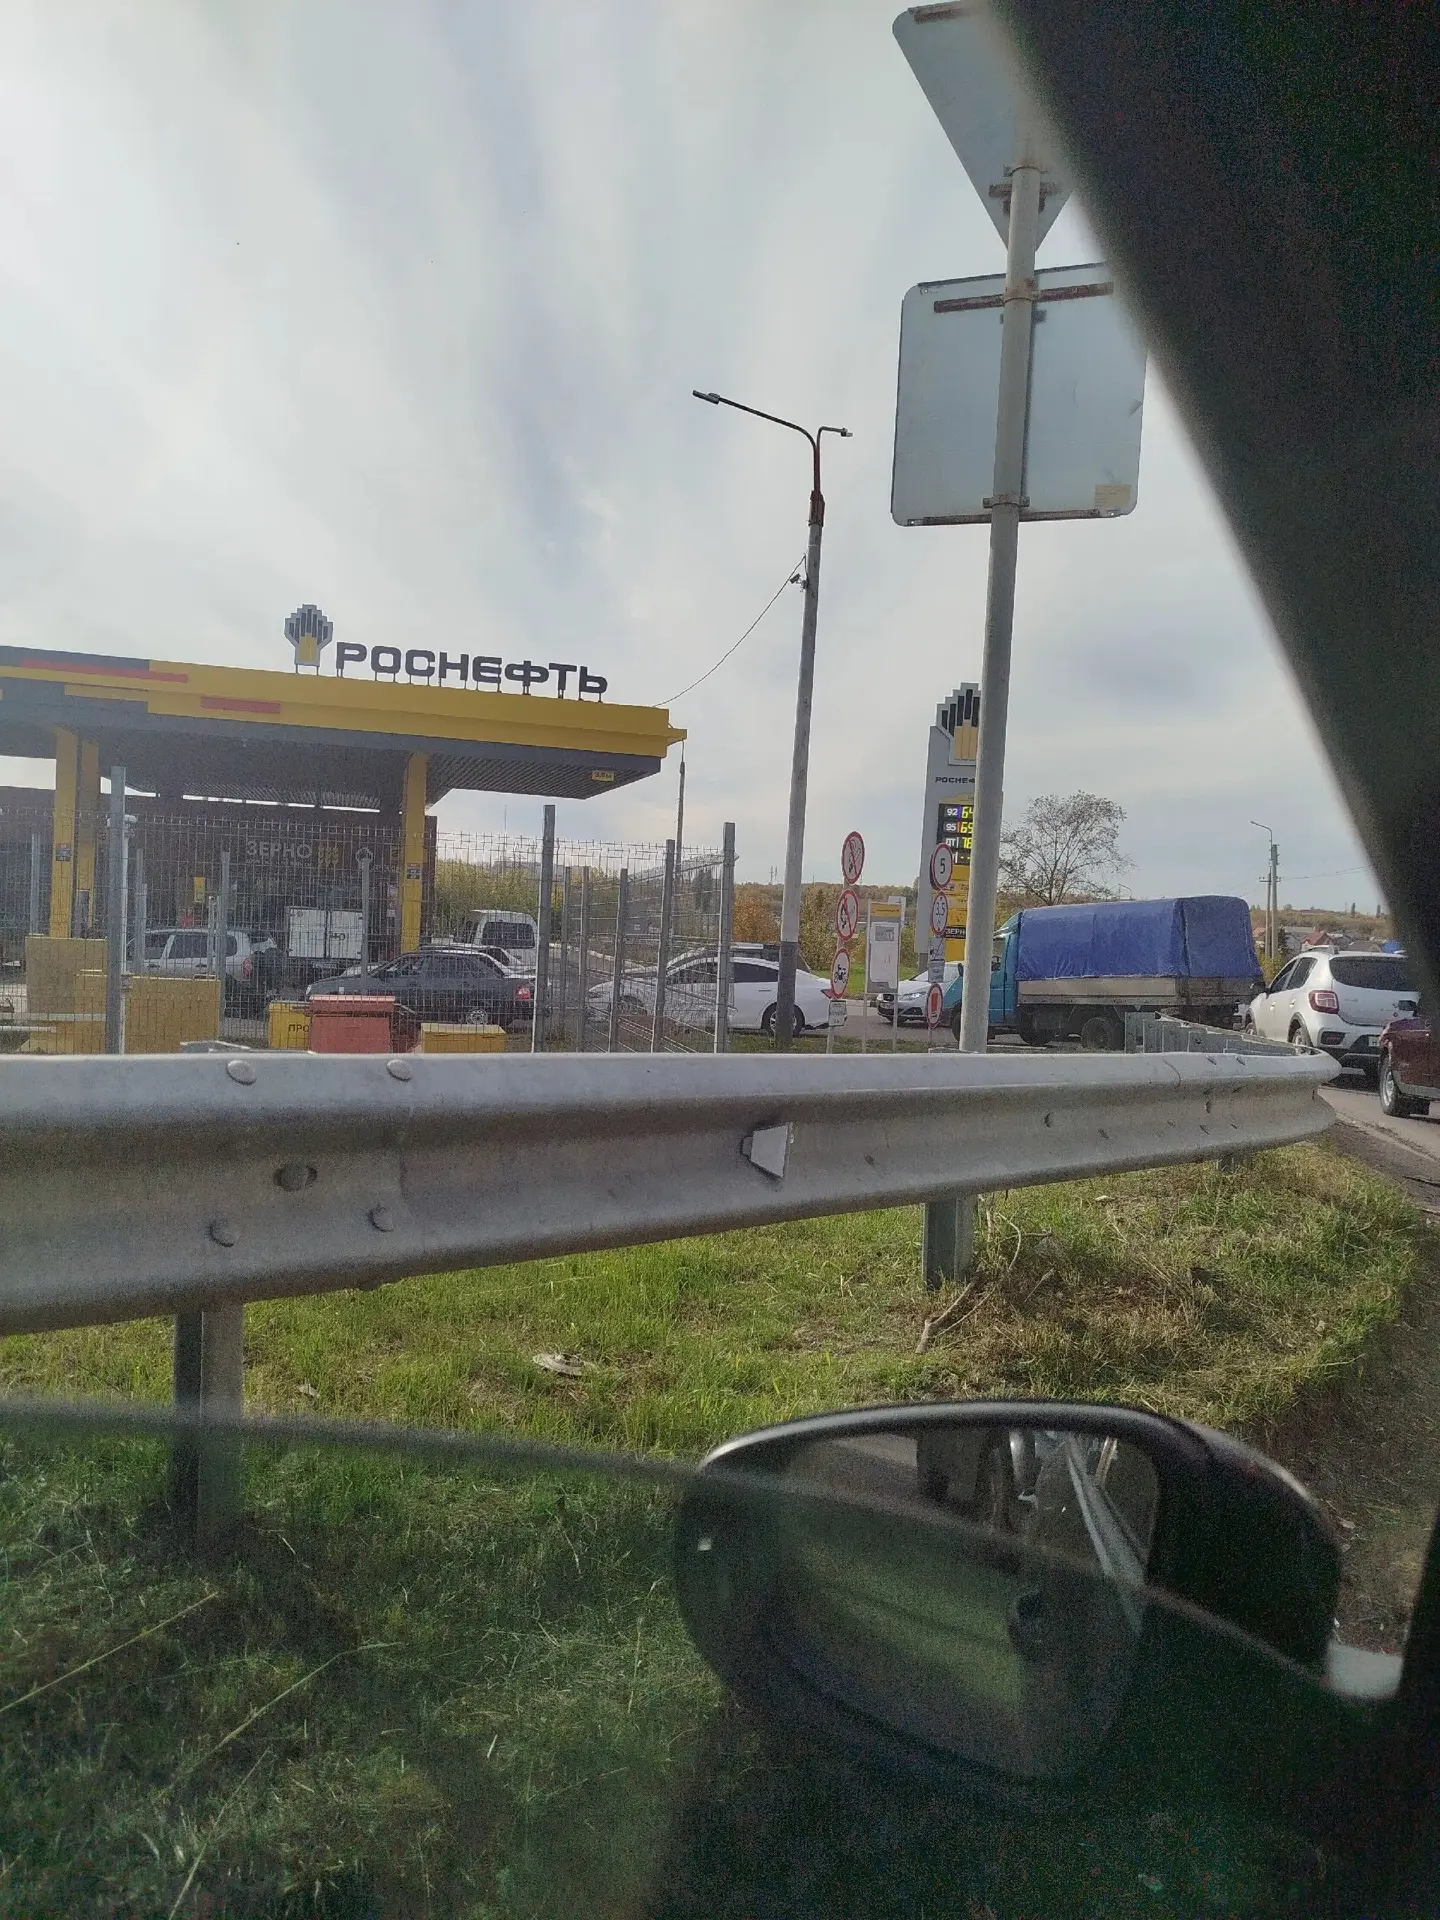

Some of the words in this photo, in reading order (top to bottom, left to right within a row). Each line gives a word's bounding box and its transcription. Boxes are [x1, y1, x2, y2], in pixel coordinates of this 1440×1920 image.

[336, 641, 608, 695] РОСНЕФТЬ
[946, 807, 958, 816] 92
[945, 823, 957, 832] 95
[246, 840, 313, 859] ЗЕРНО
[939, 857, 946, 875] 5
